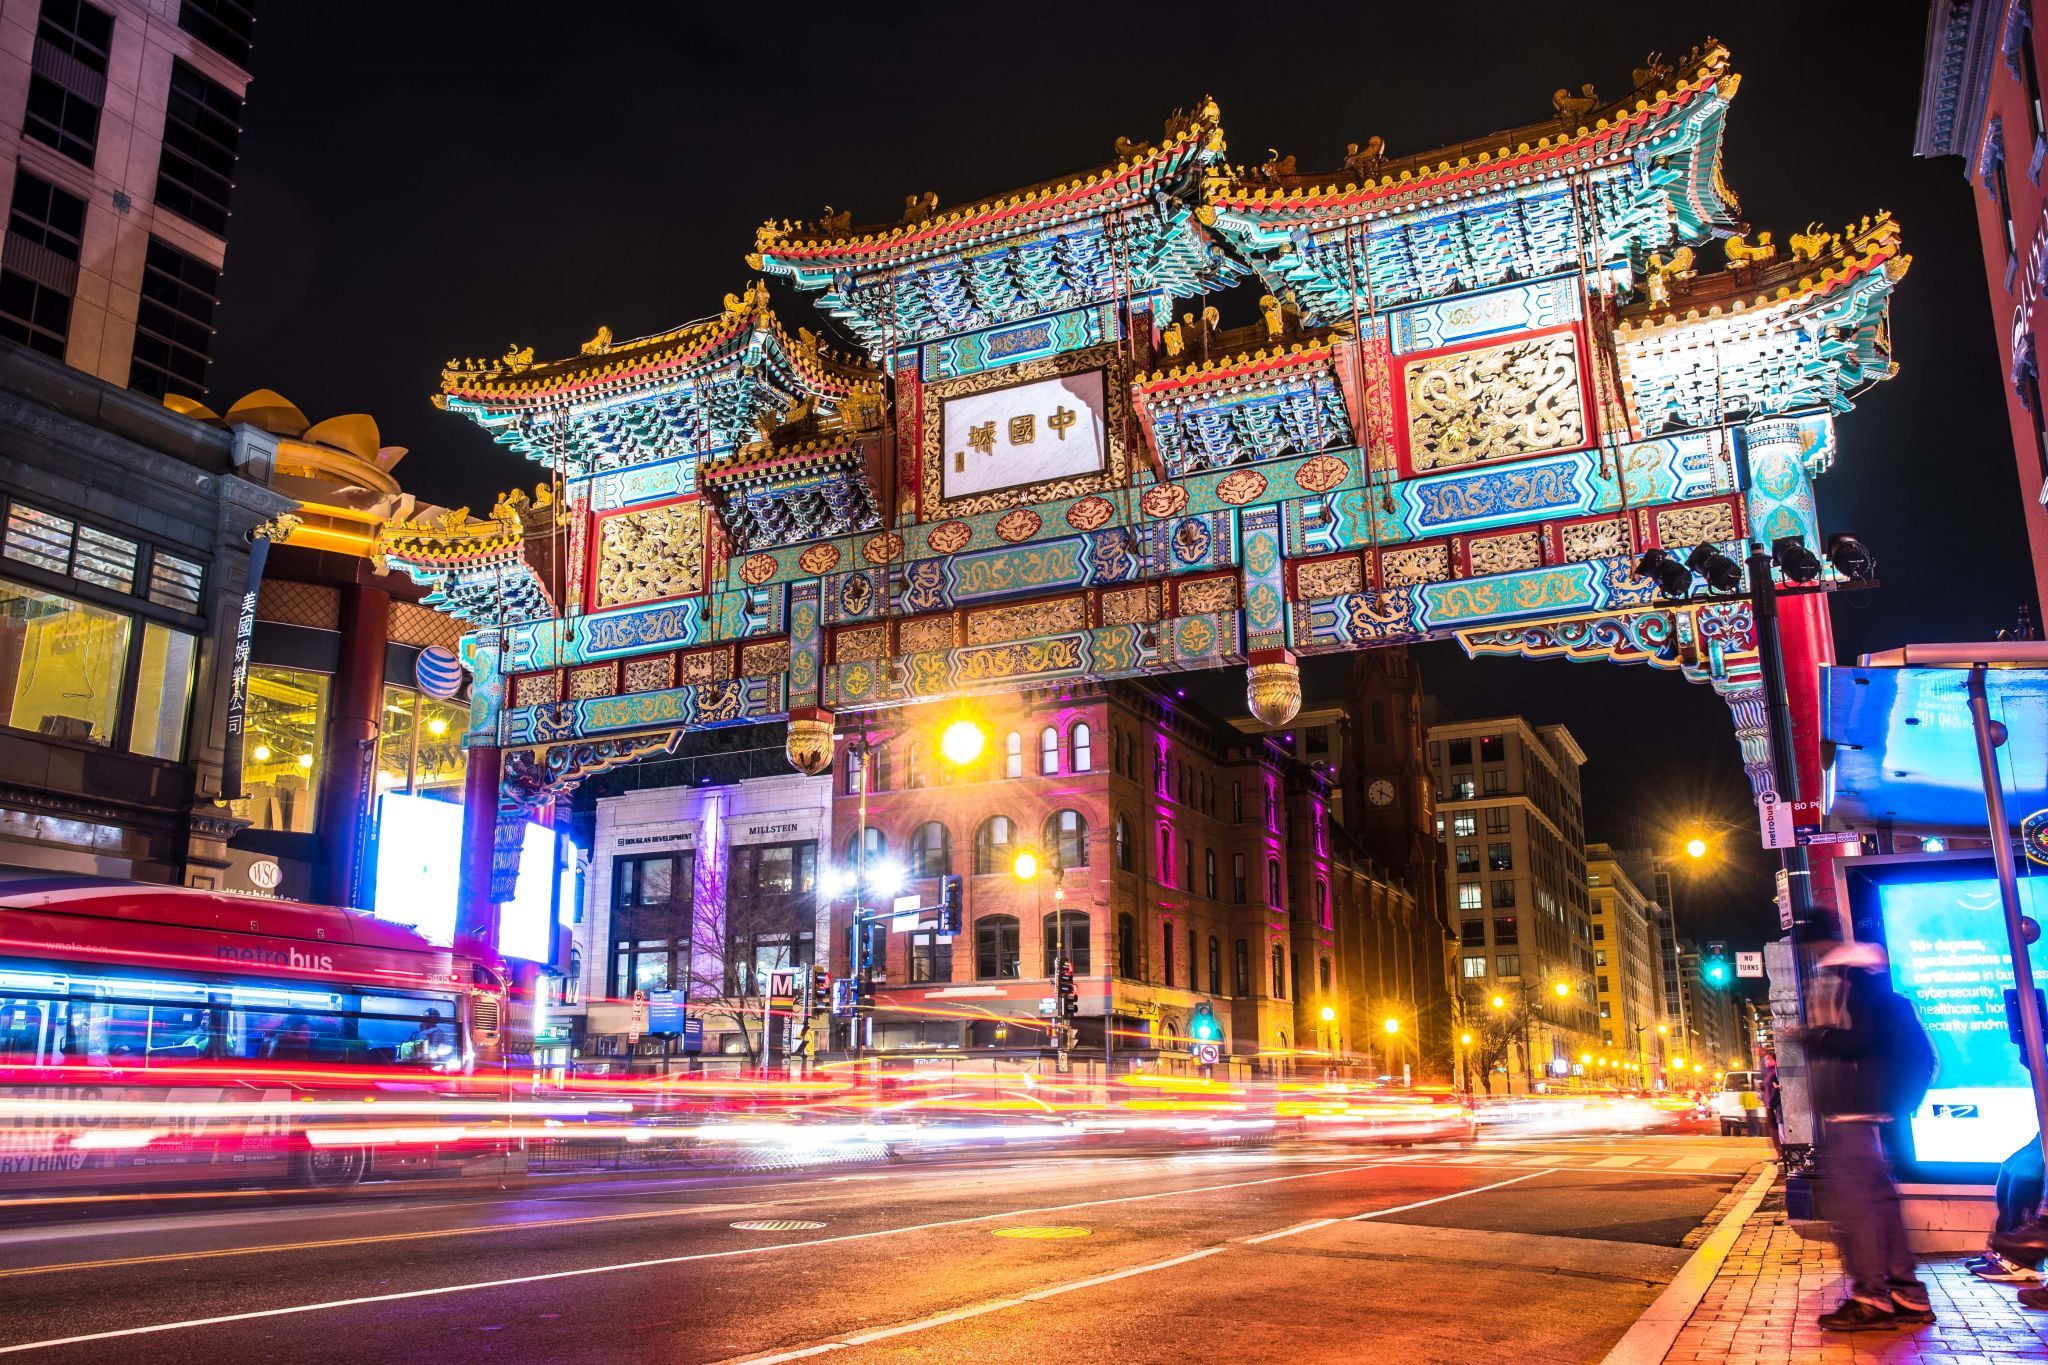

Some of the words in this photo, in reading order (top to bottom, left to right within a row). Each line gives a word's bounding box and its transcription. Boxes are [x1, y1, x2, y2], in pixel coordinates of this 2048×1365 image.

[1794, 803, 1807, 811] 80
[749, 823, 798, 835] MILLSTEIN
[1766, 805, 1777, 847] metrobus
[625, 836, 652, 845] DOUGLAS
[652, 833, 693, 842] DEVELOPMENT
[253, 863, 278, 886] WSC
[216, 944, 333, 972] metrobus
[1982, 969, 1994, 981] in
[772, 974, 793, 996] M
[1916, 985, 1998, 1001] cybersecurity,
[1919, 1002, 1984, 1015] healthcare,
[782, 1013, 791, 1042] Gallery
[1922, 1020, 1967, 1034] security
